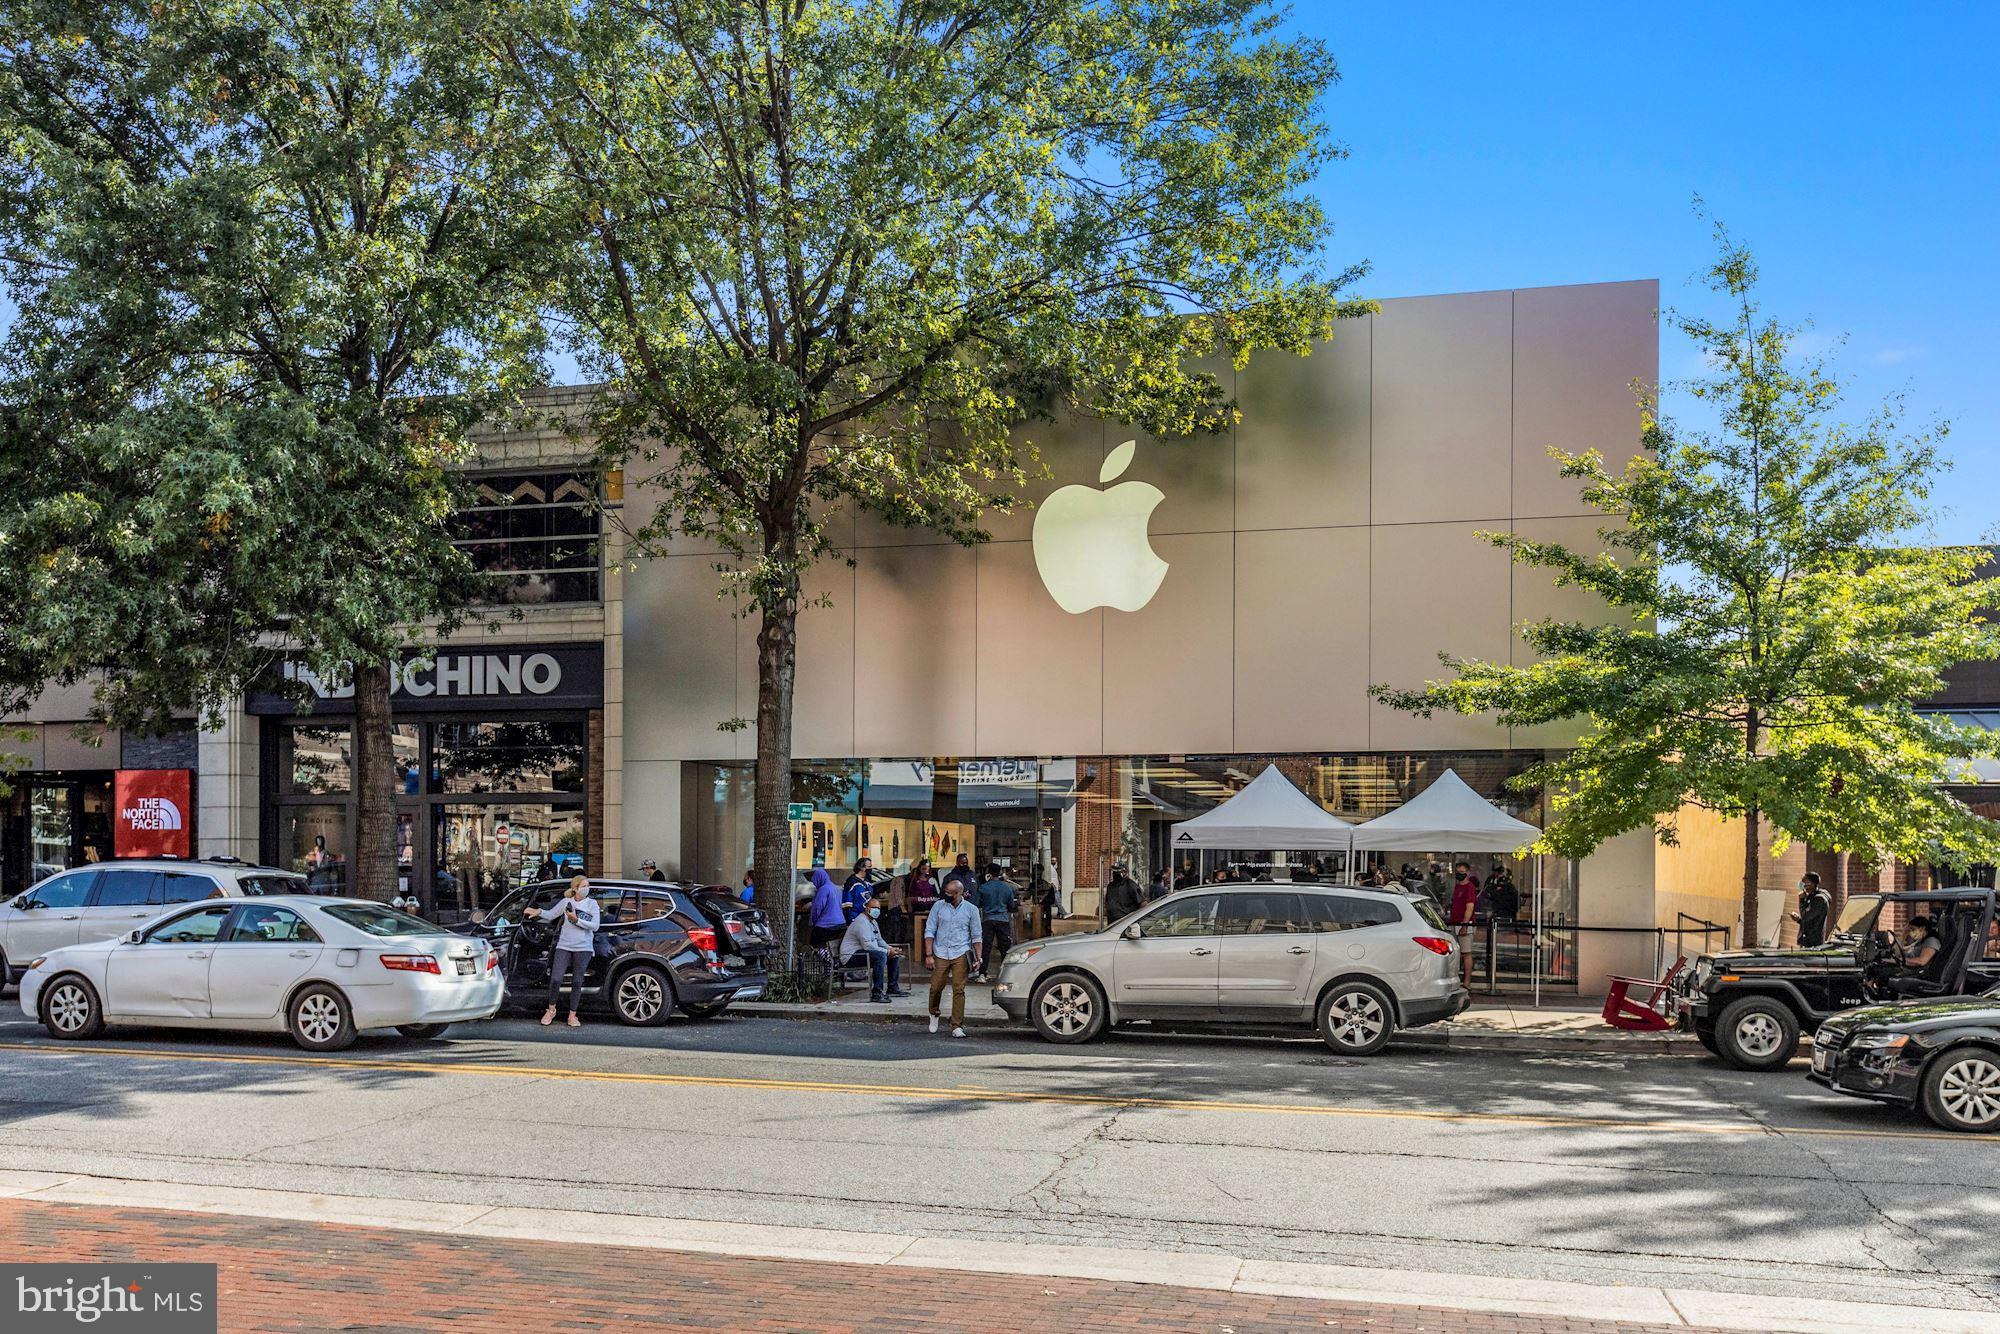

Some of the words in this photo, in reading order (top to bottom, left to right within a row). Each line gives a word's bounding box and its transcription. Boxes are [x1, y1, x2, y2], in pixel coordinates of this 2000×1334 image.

[284, 652, 562, 699] INDCHINO
[137, 797, 159, 809] THE
[123, 808, 159, 819] NORTH
[131, 819, 159, 830] FACE
[1840, 997, 1861, 1005] Jeep
